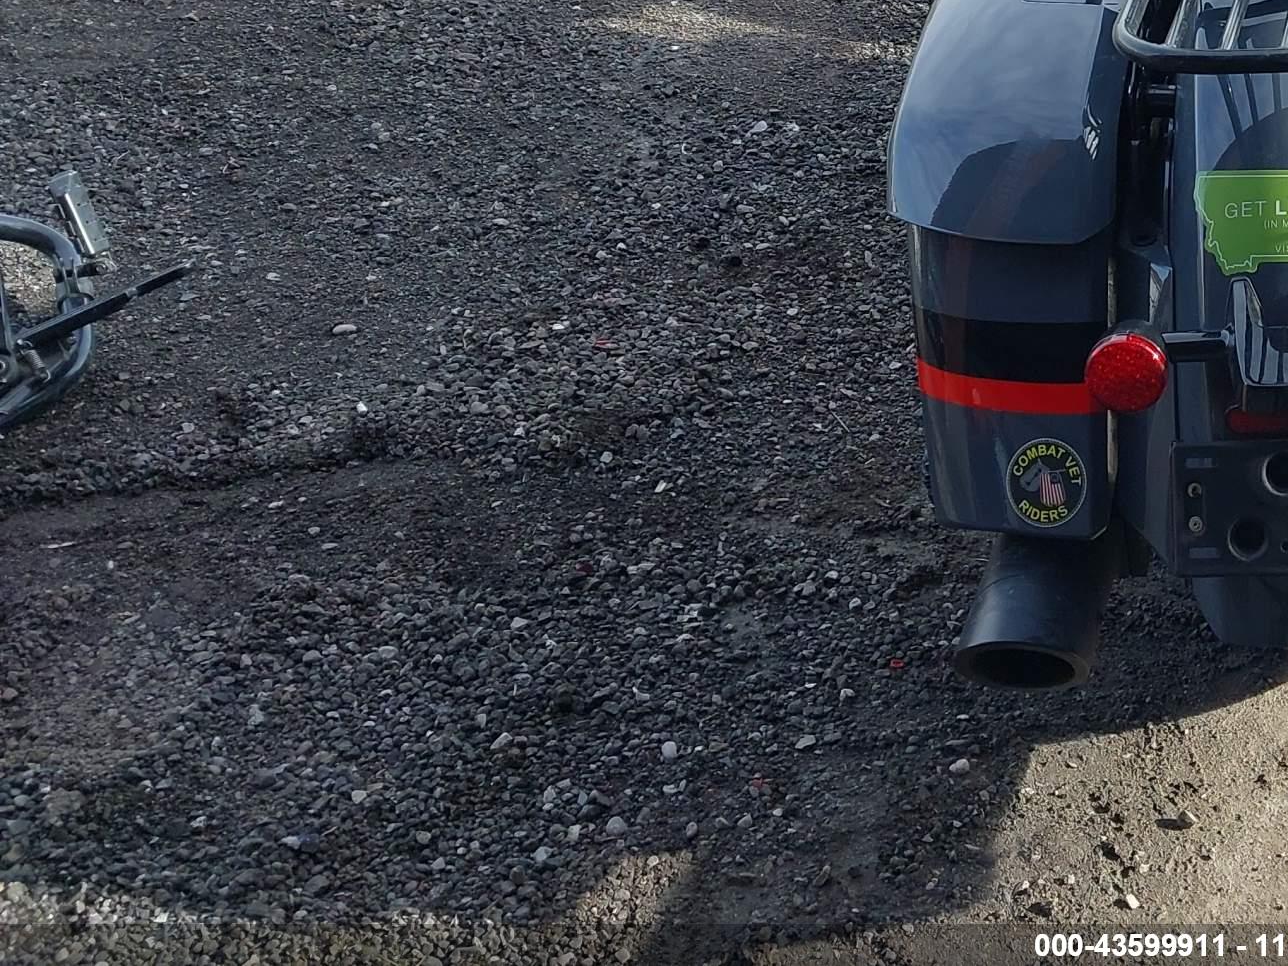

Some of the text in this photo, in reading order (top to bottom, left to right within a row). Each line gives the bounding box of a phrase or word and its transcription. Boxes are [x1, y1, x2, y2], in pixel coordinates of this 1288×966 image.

[1224, 201, 1267, 218] GET
[1013, 444, 1081, 486] COMBAT VET
[1019, 499, 1068, 522] RIDERS
